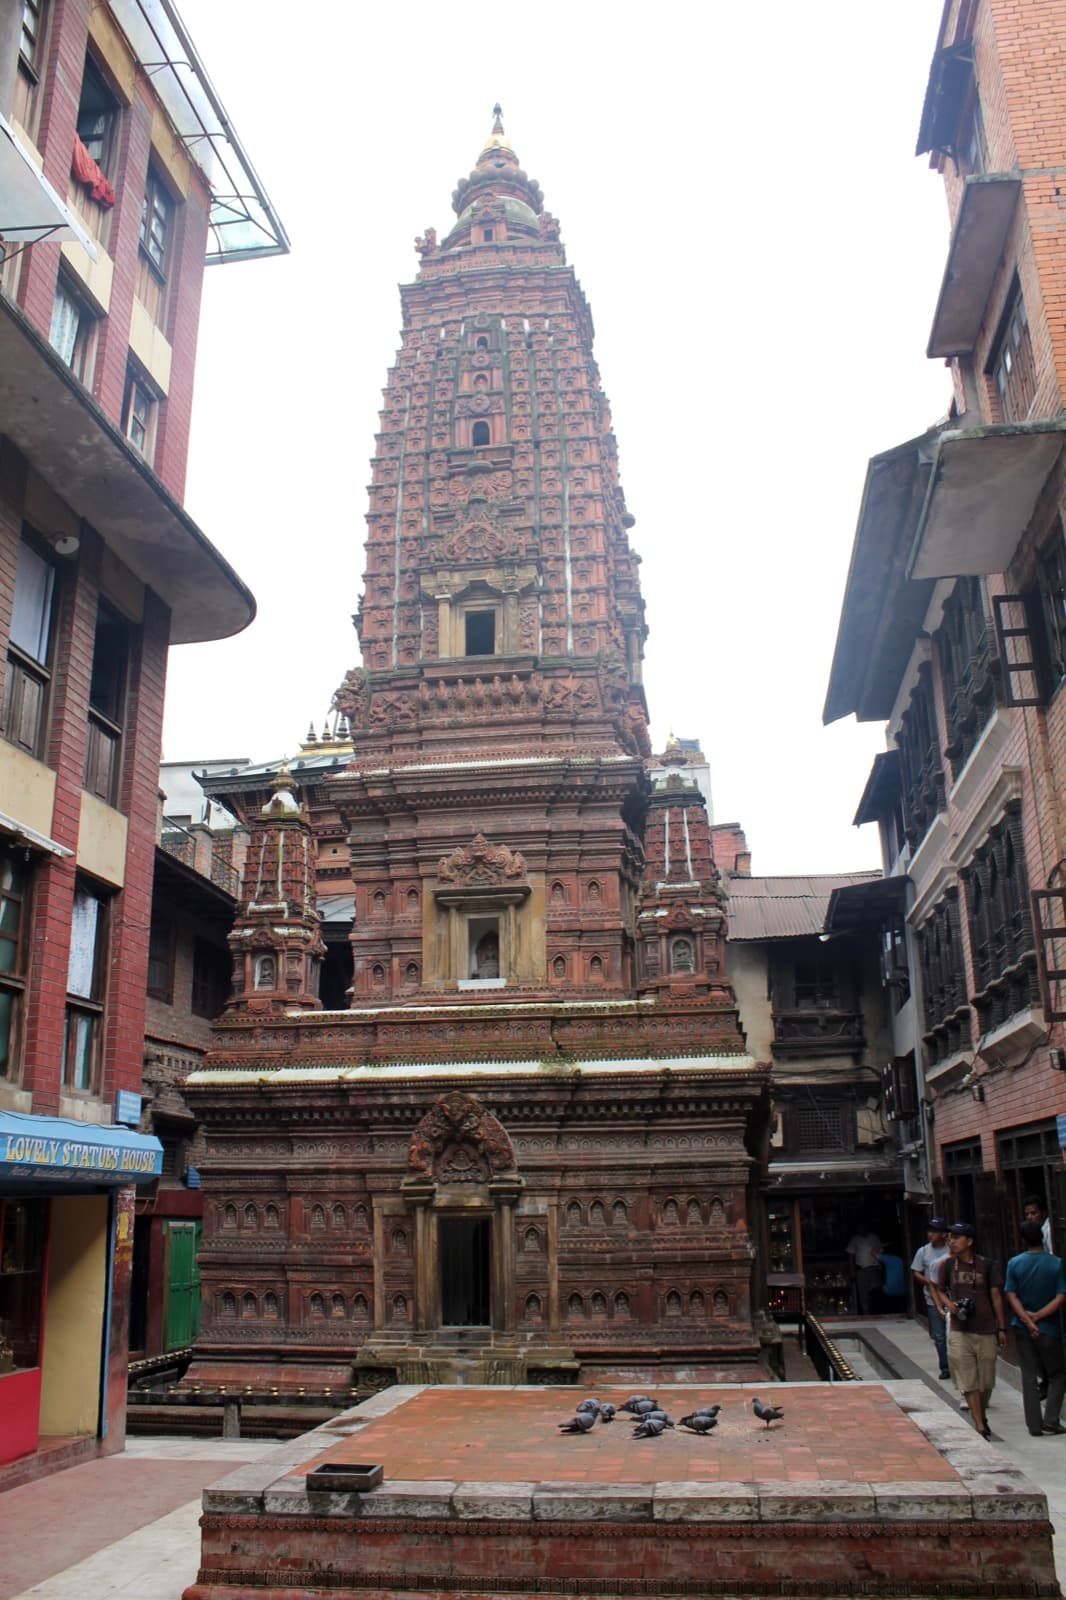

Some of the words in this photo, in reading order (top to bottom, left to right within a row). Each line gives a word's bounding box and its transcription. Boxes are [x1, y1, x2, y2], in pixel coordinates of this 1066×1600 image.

[5, 1136, 60, 1164] LOVELY
[62, 1141, 119, 1169] STATUES
[121, 1149, 155, 1172] HOUSE
